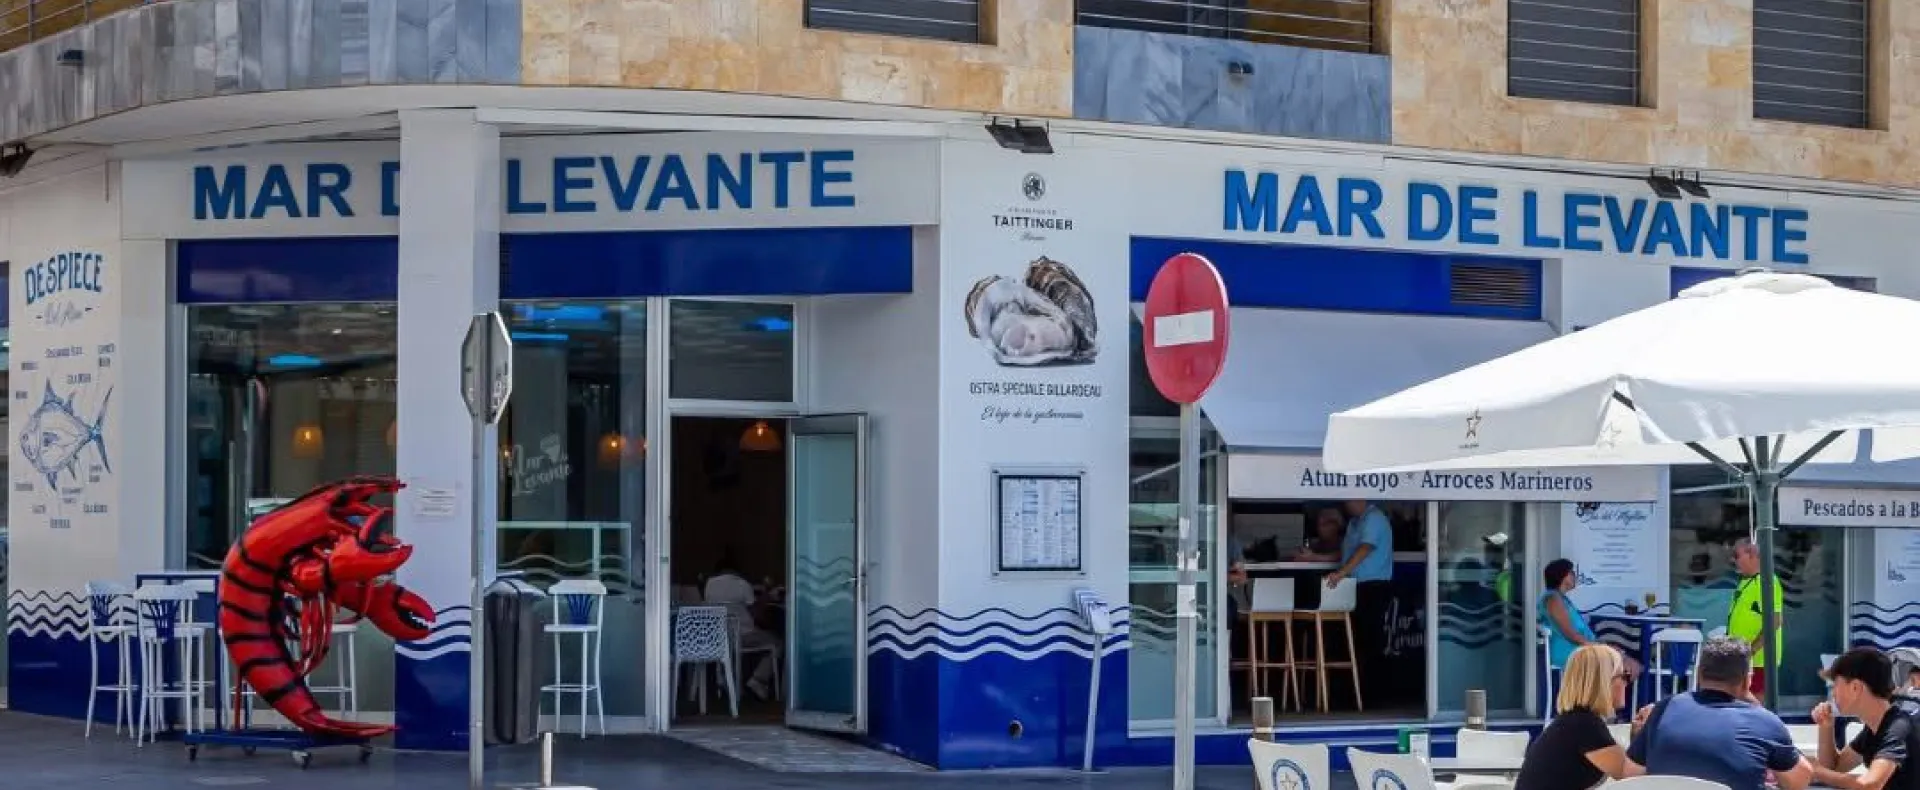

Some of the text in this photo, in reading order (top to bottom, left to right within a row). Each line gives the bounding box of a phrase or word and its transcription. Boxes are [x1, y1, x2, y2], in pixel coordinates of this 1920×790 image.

[193, 163, 355, 220] MAR
[507, 150, 855, 214] LEVANTE
[992, 215, 1072, 230] TAITTINGER
[1223, 170, 1809, 264] MAR DE LEVANTE
[25, 252, 102, 305] DESPIECE
[1421, 469, 1494, 490] Arroces
[1500, 470, 1592, 491] Marineros
[1803, 498, 1875, 517] Pescados
[1879, 504, 1887, 517] a
[1891, 500, 1905, 517] la
